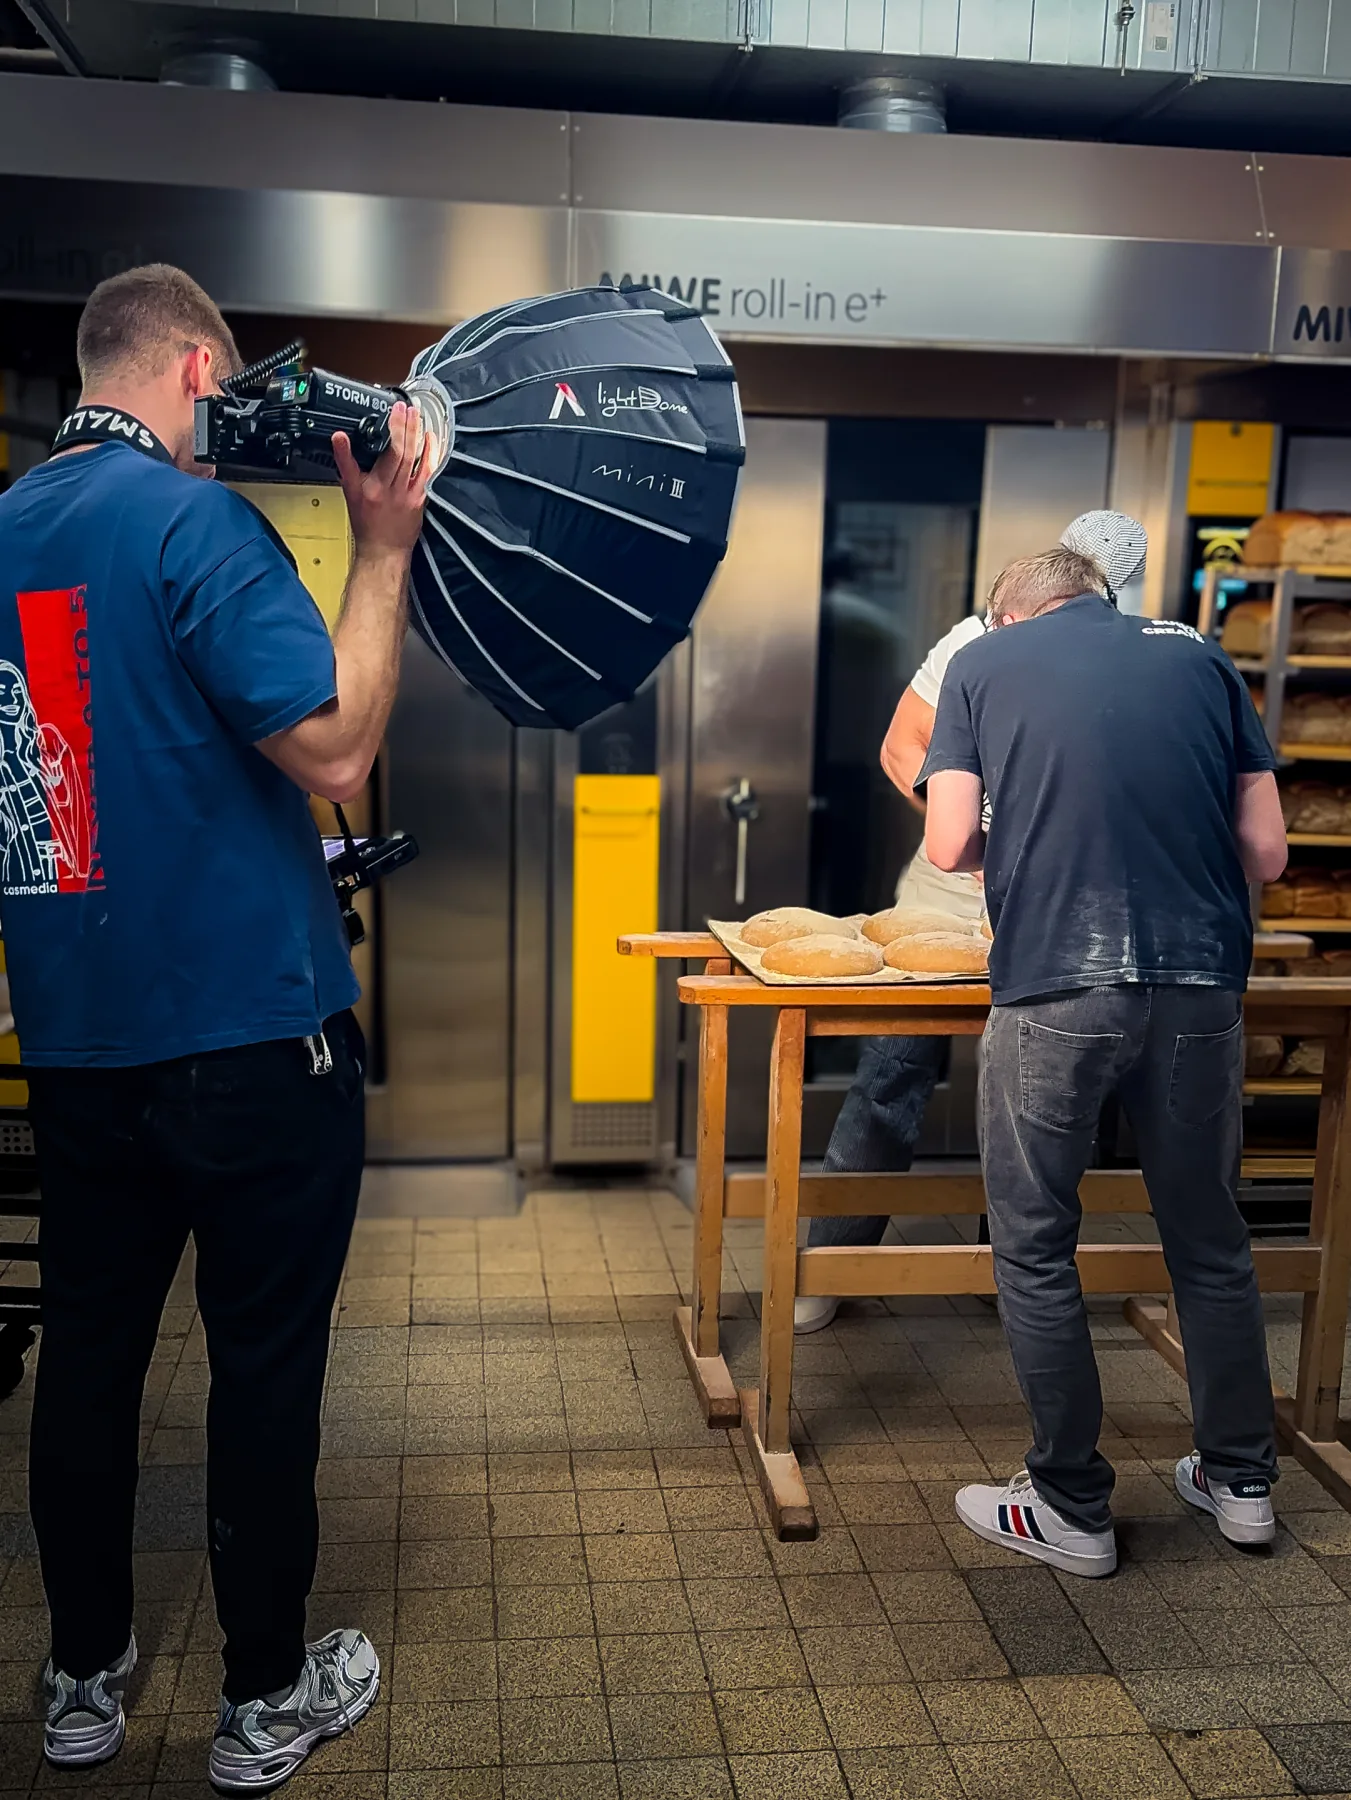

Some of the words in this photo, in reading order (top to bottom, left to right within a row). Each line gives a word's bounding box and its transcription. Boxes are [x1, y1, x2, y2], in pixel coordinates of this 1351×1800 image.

[731, 278, 836, 322] roll-in
[1293, 305, 1351, 342] MI
[325, 382, 370, 408] STORM
[55, 410, 154, 448] SMALL
[592, 465, 666, 492] mini
[1242, 1484, 1267, 1493] adidas
